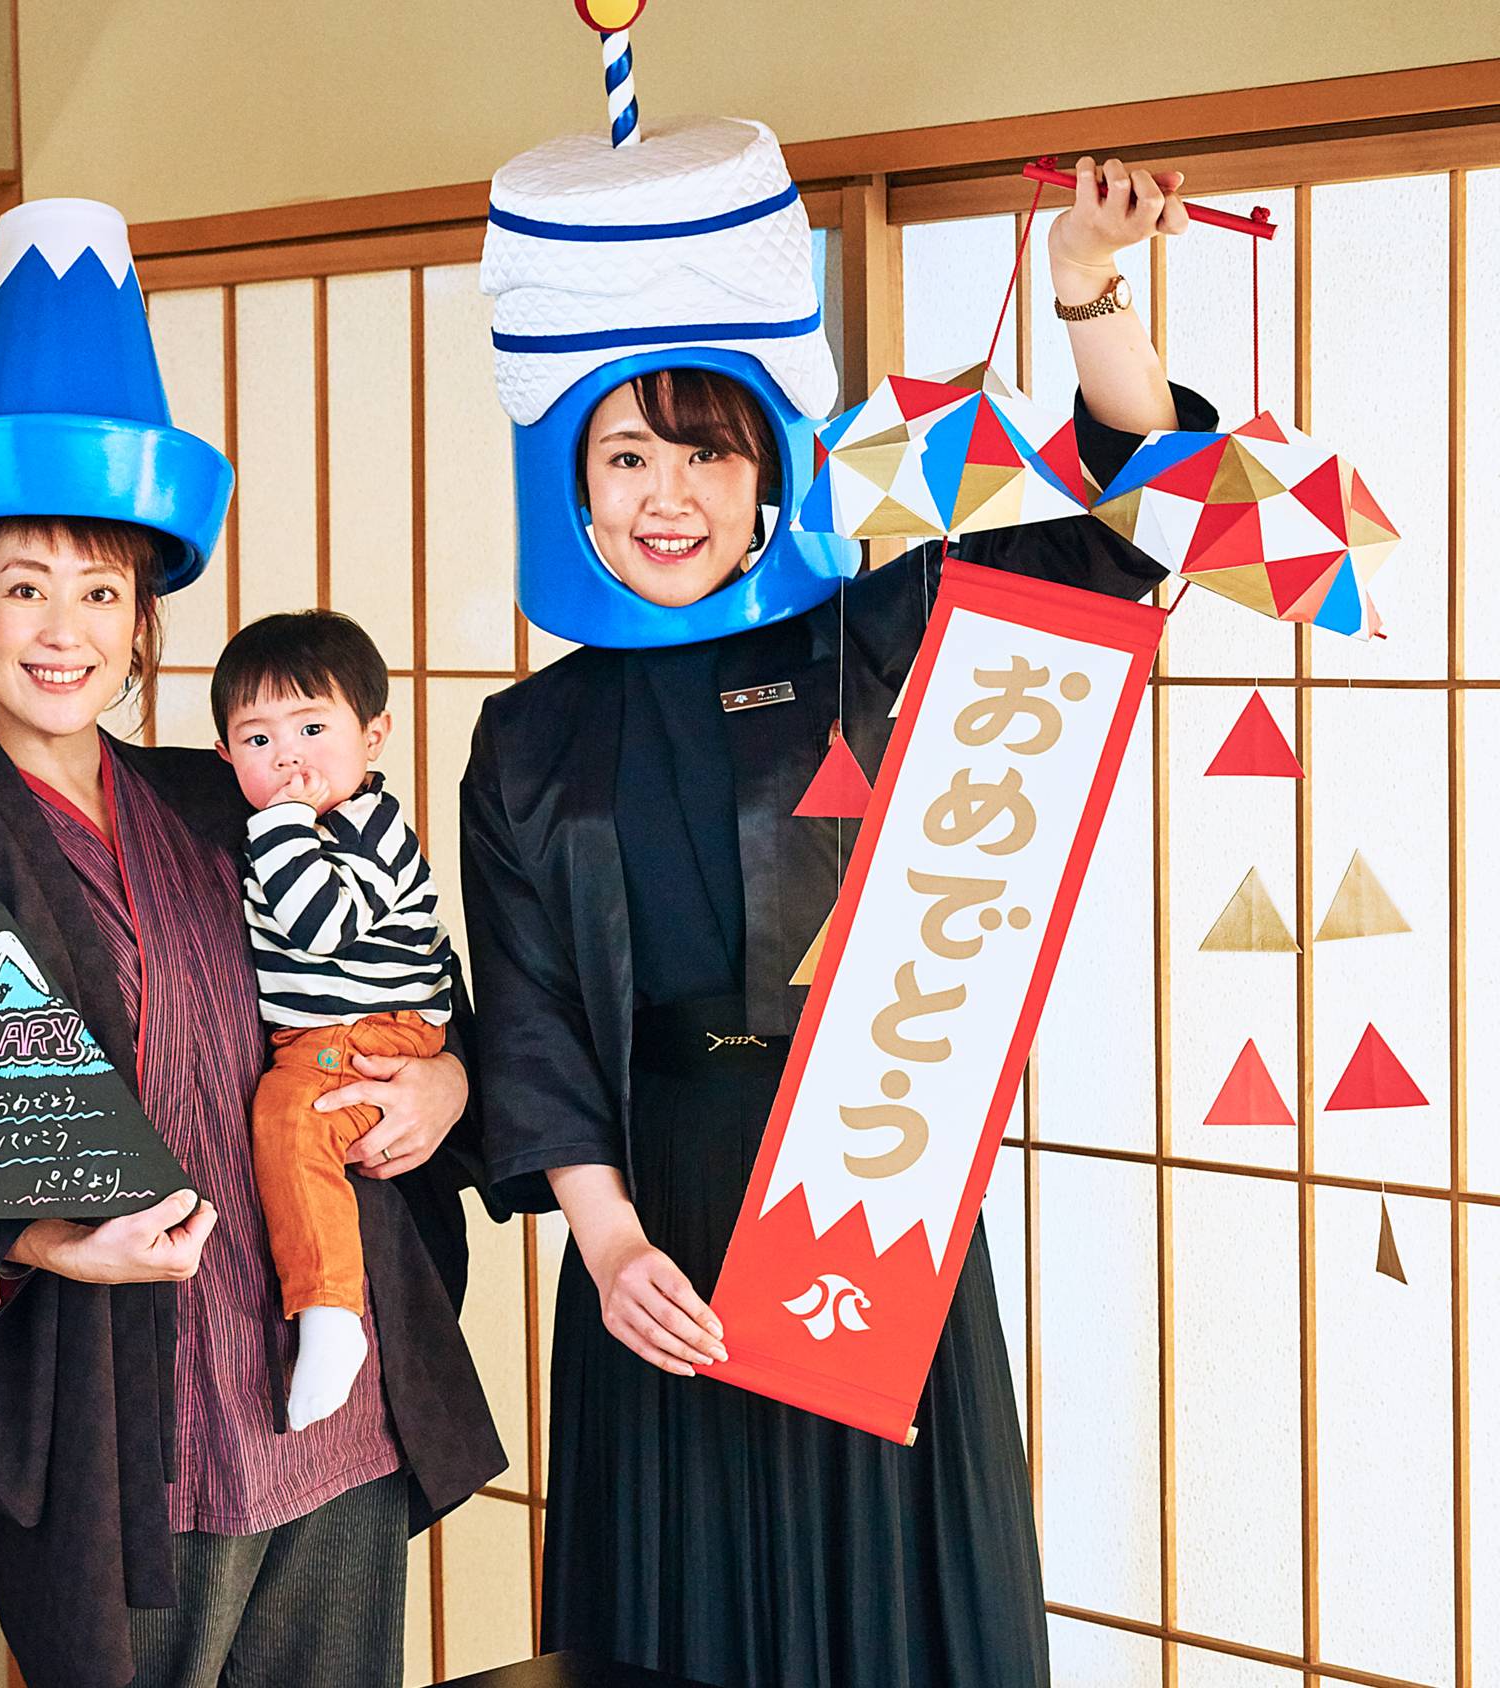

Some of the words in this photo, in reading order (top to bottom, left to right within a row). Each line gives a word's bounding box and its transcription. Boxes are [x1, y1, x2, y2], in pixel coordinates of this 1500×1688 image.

[838, 653, 1091, 1179] おめでとう
[35, 1167, 121, 1203] パパより
